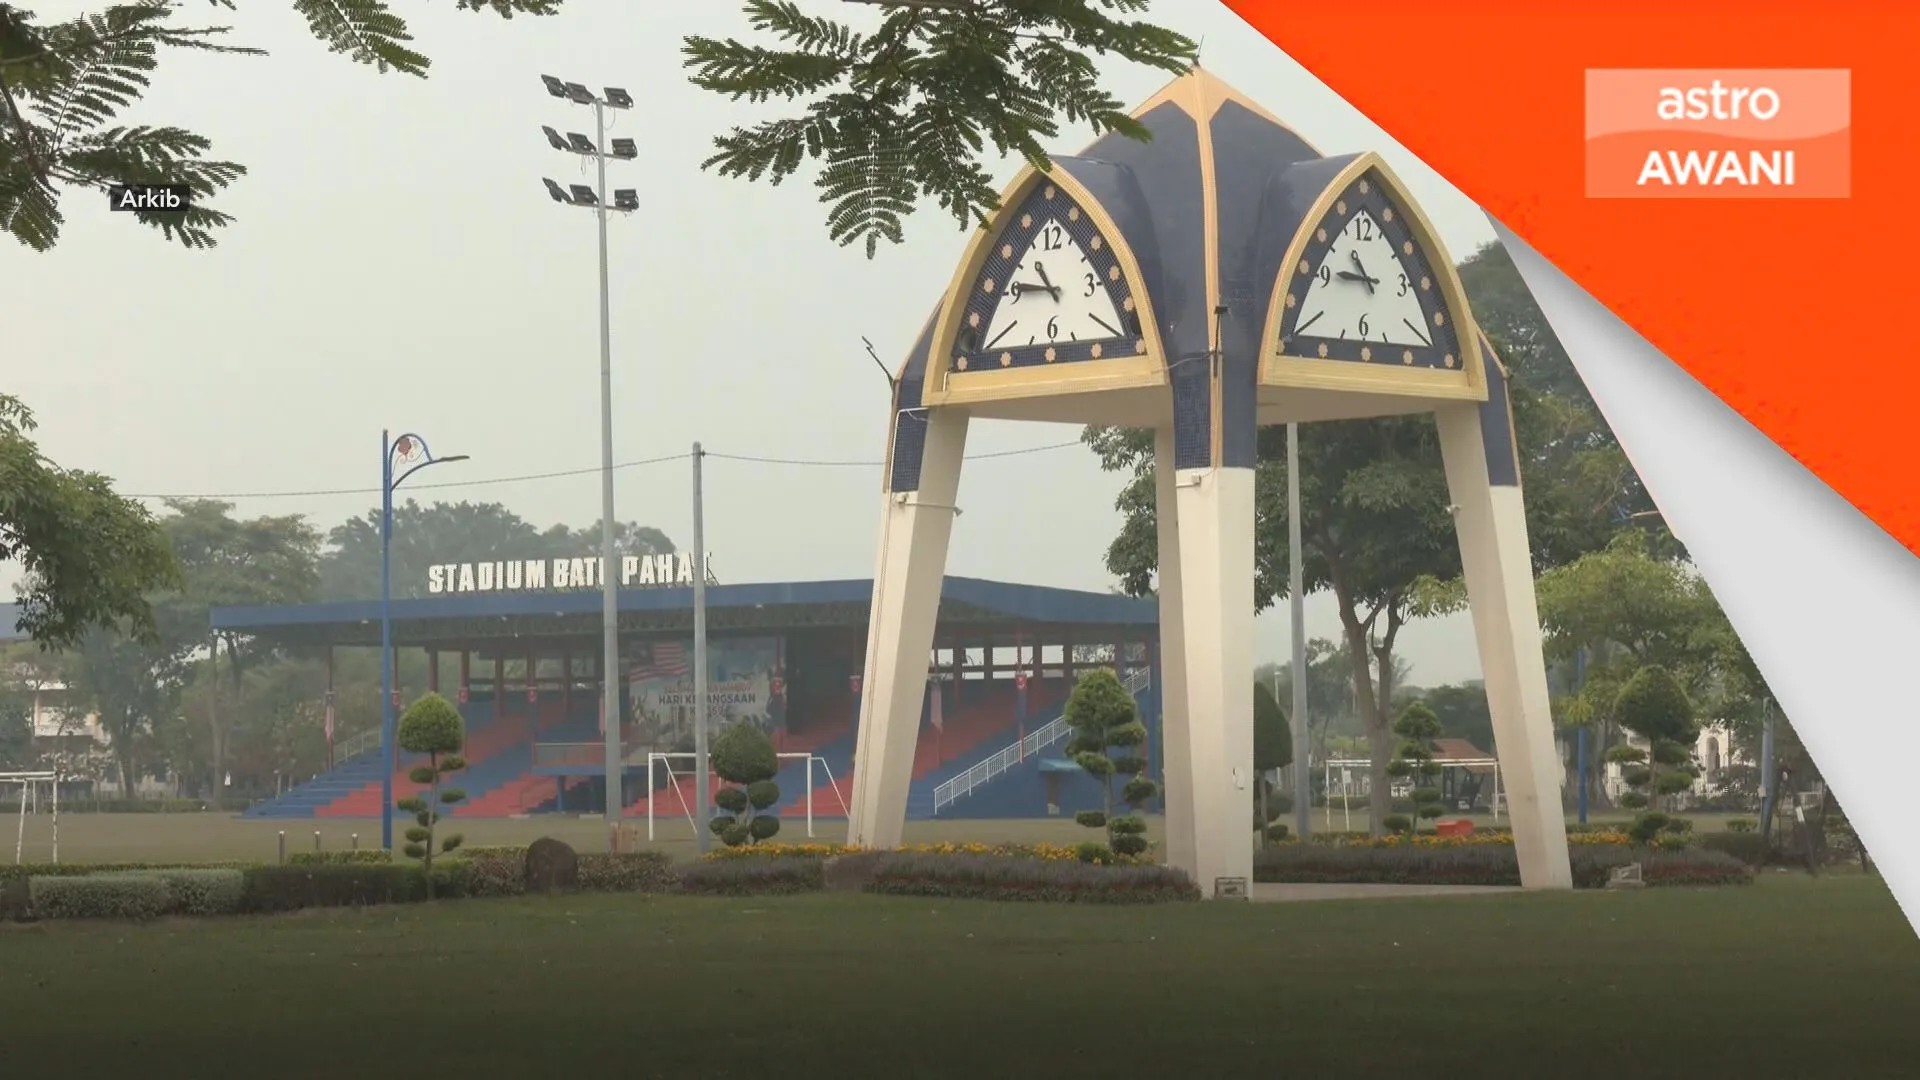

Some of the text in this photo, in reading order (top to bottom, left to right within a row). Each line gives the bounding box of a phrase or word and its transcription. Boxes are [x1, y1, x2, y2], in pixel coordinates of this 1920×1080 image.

[1043, 226, 1062, 251] 12
[1354, 218, 1372, 242] 12
[1084, 273, 1096, 298] 3
[1320, 265, 1331, 289] 9
[1397, 273, 1408, 297] 3
[1010, 281, 1022, 305] 9
[1047, 315, 1058, 339] 6
[1358, 313, 1369, 337] 6
[428, 559, 546, 593] STADIUM
[658, 695, 683, 706] HARI
